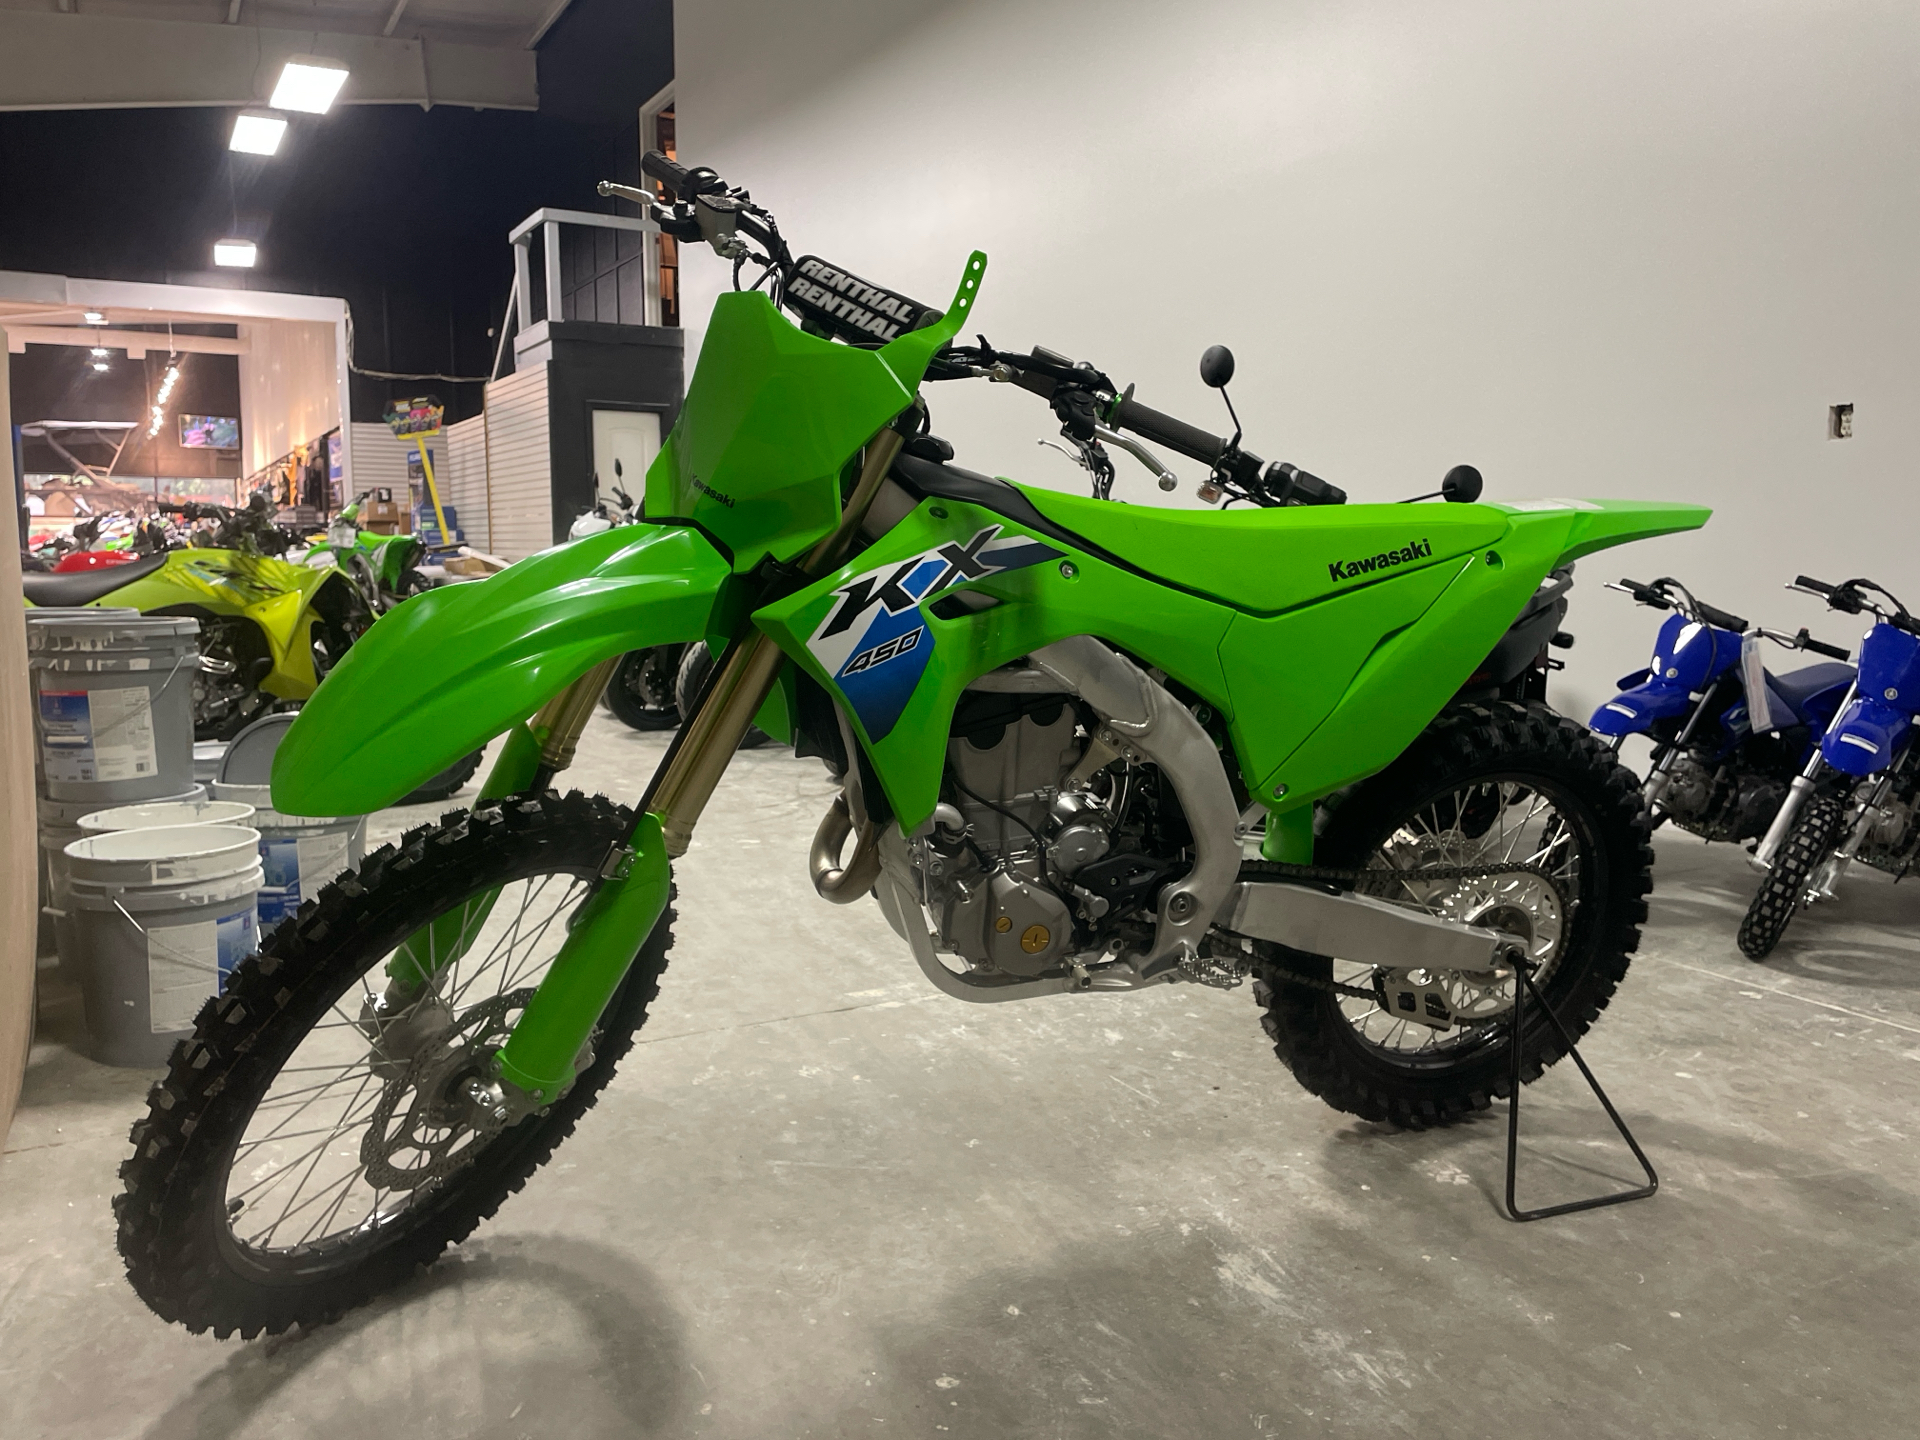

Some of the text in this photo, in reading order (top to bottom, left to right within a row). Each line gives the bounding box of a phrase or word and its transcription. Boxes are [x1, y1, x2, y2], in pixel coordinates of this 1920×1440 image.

[787, 276, 900, 342] RENTHAL
[799, 259, 913, 325] RENTHAL
[690, 472, 736, 509] Kawasaki
[817, 526, 1001, 641] KX
[1328, 538, 1432, 582] Kawasaki
[842, 626, 925, 677] 450
